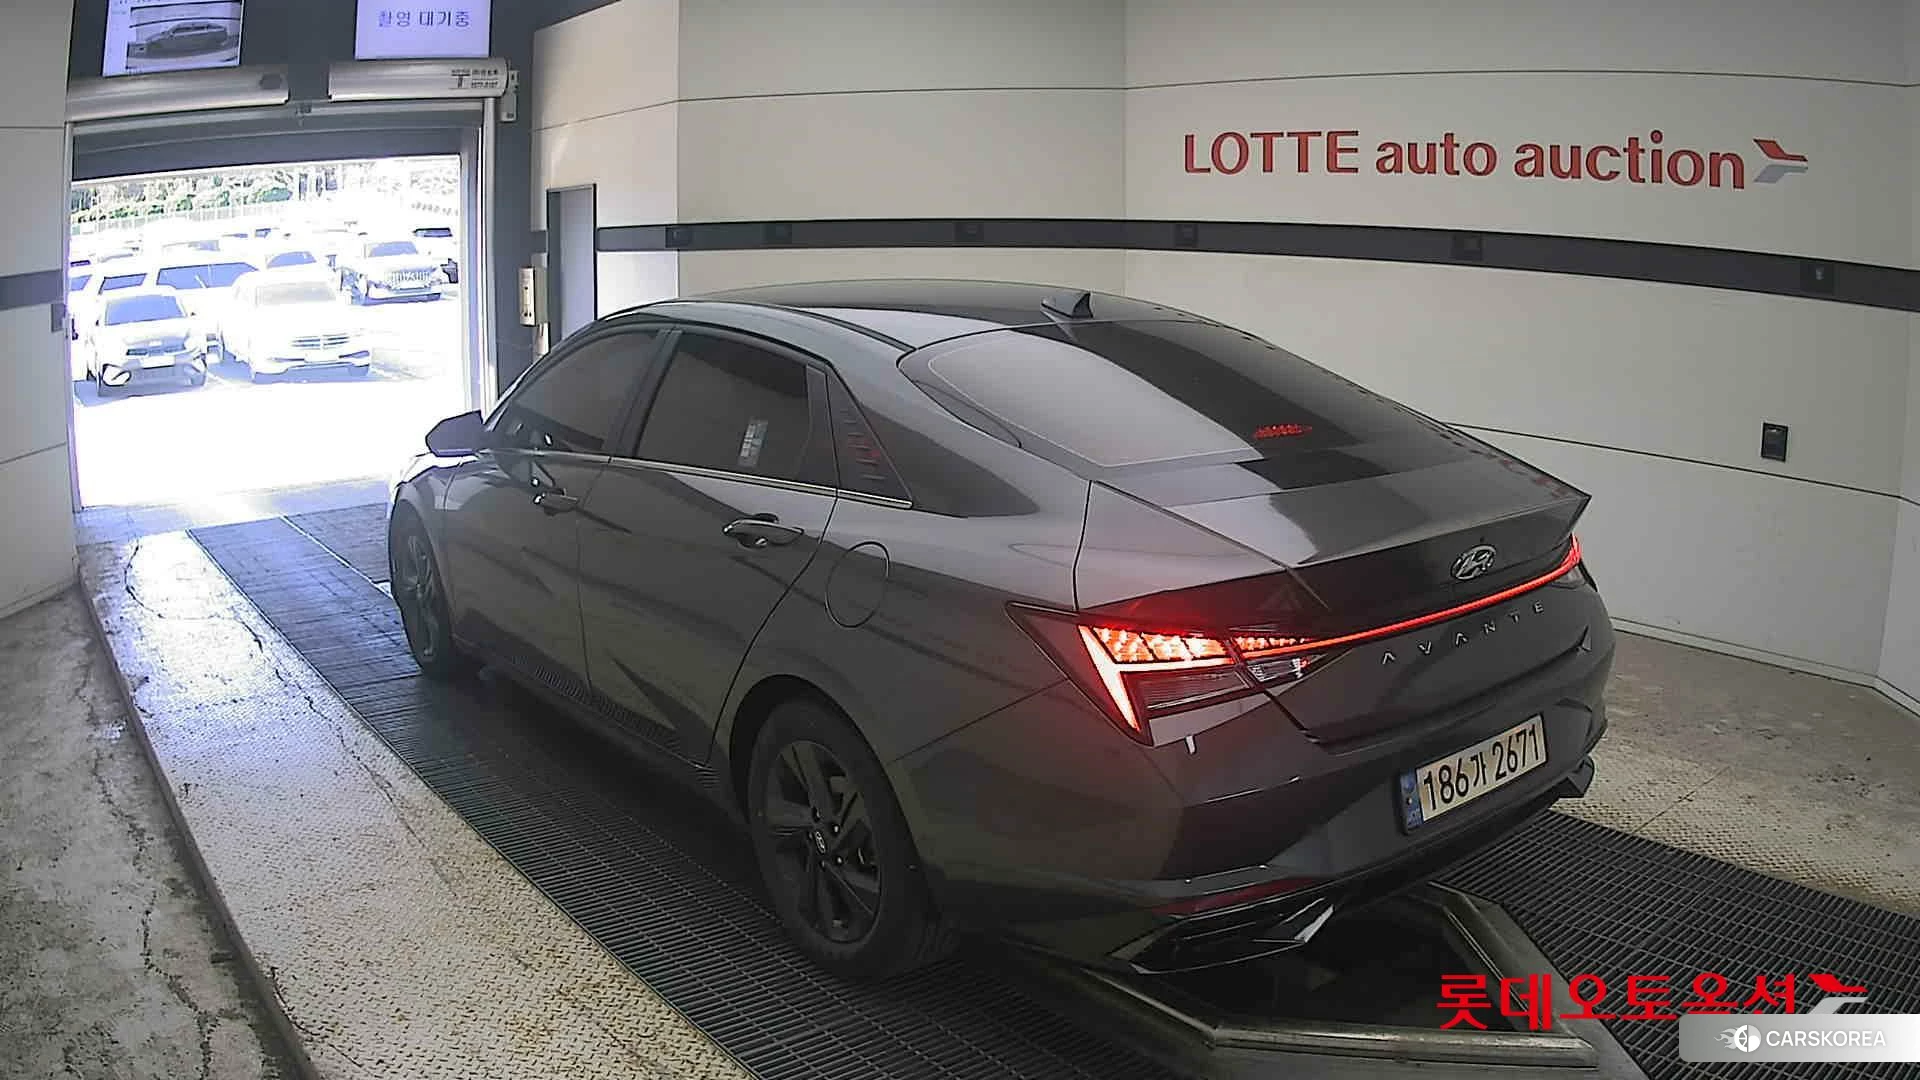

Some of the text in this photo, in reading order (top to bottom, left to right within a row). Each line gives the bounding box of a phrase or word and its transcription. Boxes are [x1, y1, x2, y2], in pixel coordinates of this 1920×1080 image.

[419, 11, 470, 28] 대기중
[1184, 129, 1745, 190] LOTTE auto auction
[1382, 601, 1545, 665] AVANTE
[1492, 724, 1539, 781] 2671
